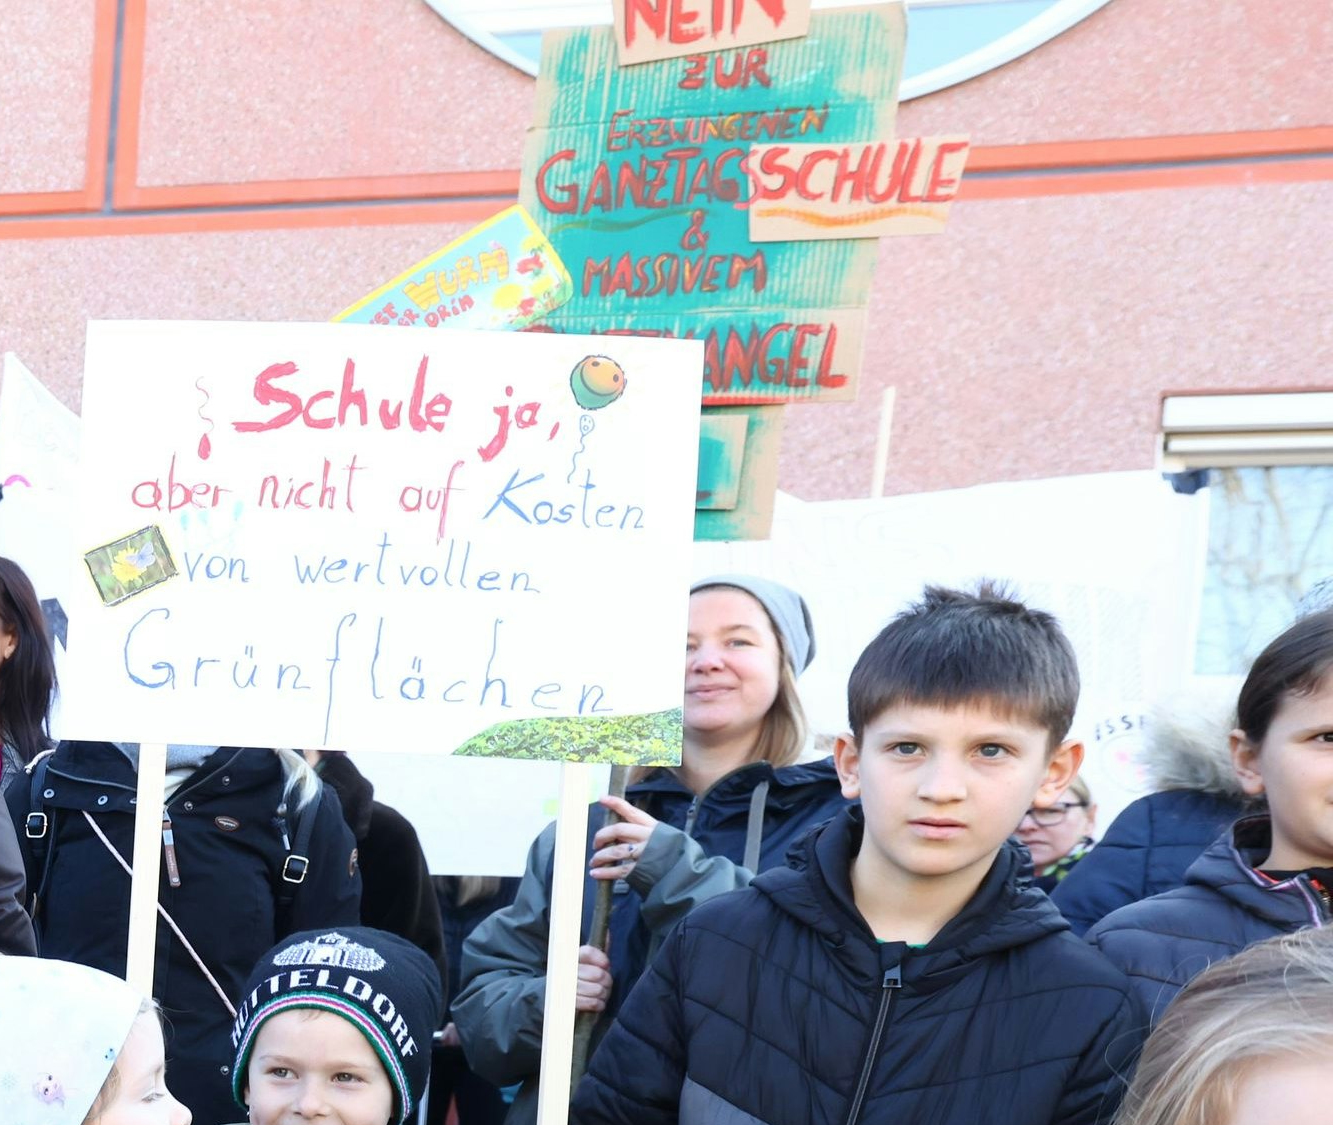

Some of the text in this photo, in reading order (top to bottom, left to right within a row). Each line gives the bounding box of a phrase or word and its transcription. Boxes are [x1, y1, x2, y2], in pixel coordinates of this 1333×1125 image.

[678, 49, 772, 90] ZUR
[607, 101, 830, 153] ERZWUNGENEN
[681, 209, 710, 252] &
[580, 250, 768, 299] MASSIVEM
[232, 354, 560, 462] Schule ja,
[132, 452, 644, 545] aber nicht auf Kosten
[184, 530, 541, 594] von wertvollen
[122, 607, 614, 747] Grünflächen
